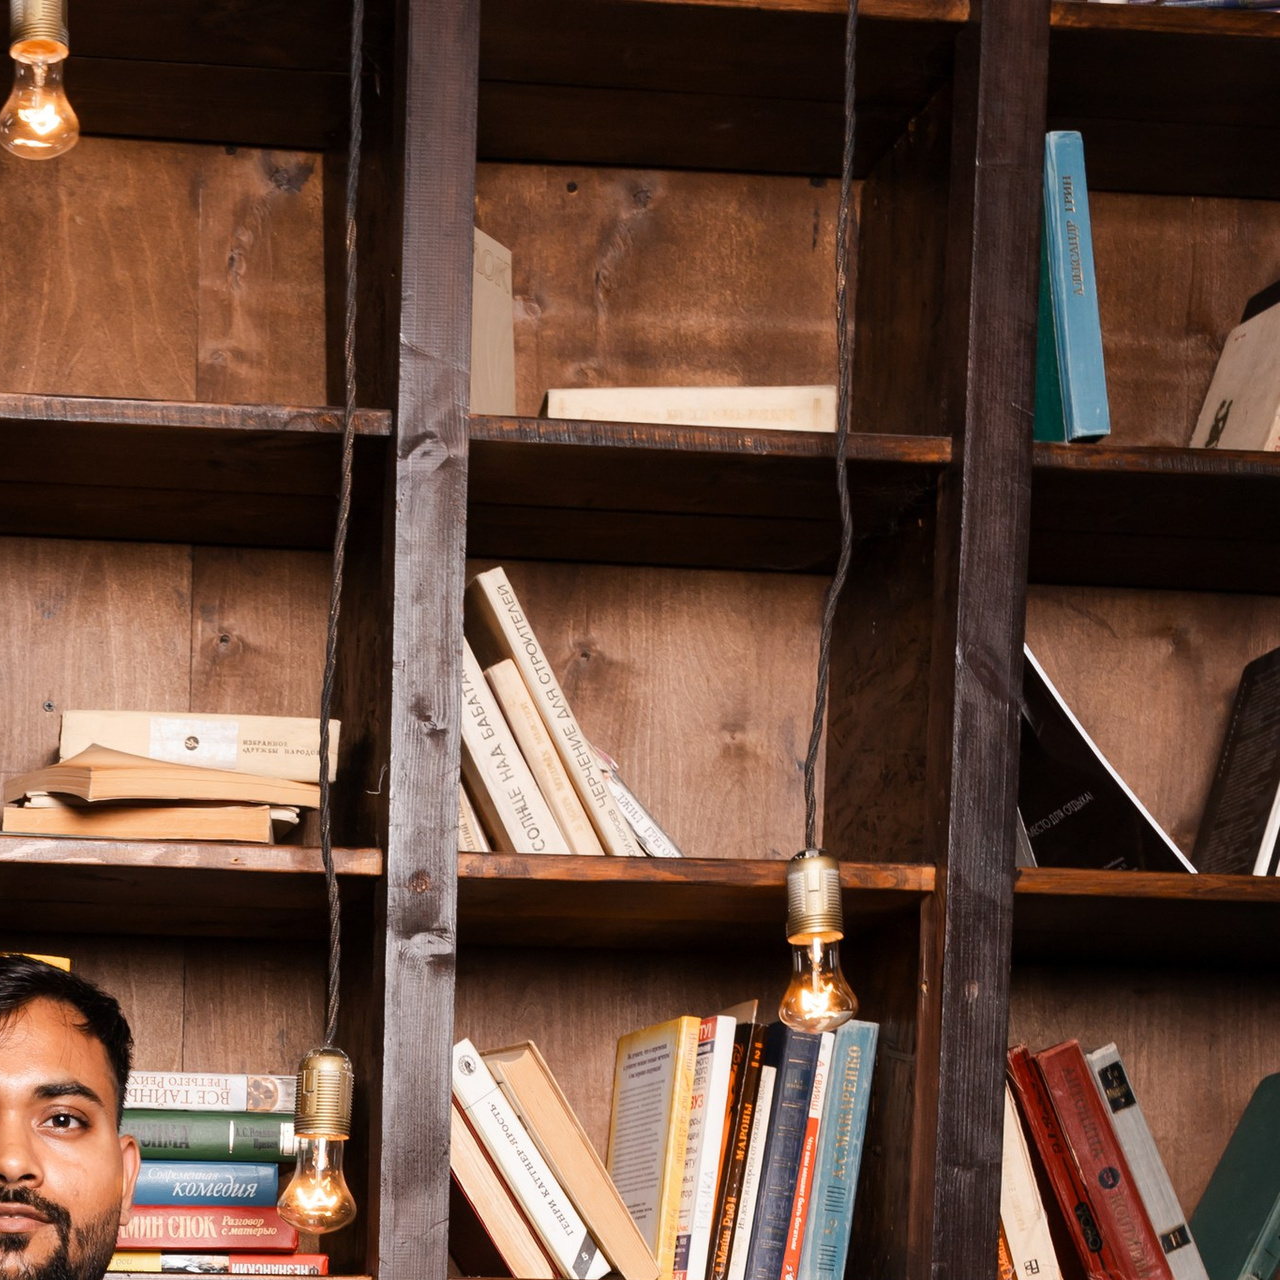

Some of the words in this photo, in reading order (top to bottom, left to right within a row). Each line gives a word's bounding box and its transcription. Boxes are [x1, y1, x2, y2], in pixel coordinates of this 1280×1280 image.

[1061, 175, 1077, 213] ГРИН
[1066, 220, 1085, 296] АЛЕКСАНДР
[495, 581, 553, 688] СТРОИТЕЛЕЙ
[545, 686, 570, 722] ДЛЯ
[487, 742, 515, 782] НАД
[561, 721, 611, 808] ЧЕРЧЕНИЕ
[506, 785, 547, 853] СОЛНЦЕ
[614, 789, 645, 824] ДЖИЛ
[1048, 807, 1066, 825] ДЛЯ
[1061, 789, 1095, 817] ОТДЫХА!
[196, 1090, 230, 1105] ВСЕ
[809, 1072, 824, 1112] СВИЯШ
[829, 1043, 863, 1181] А.С.МАКАРЕНКО
[735, 1102, 753, 1161] МАРОНЫ
[148, 1167, 221, 1181] Современная
[802, 1151, 811, 1166] вам
[172, 1174, 258, 1197] комедия
[798, 1166, 809, 1196] мешает
[222, 1213, 265, 1228] Разговор
[546, 1198, 574, 1236] ГЕНРИ
[720, 1203, 735, 1228] Рид
[794, 1196, 805, 1217] быть
[166, 1215, 218, 1239] СПОК
[230, 1226, 277, 1238] матерью
[789, 1216, 802, 1251] богатым
[715, 1231, 731, 1263] Майн
